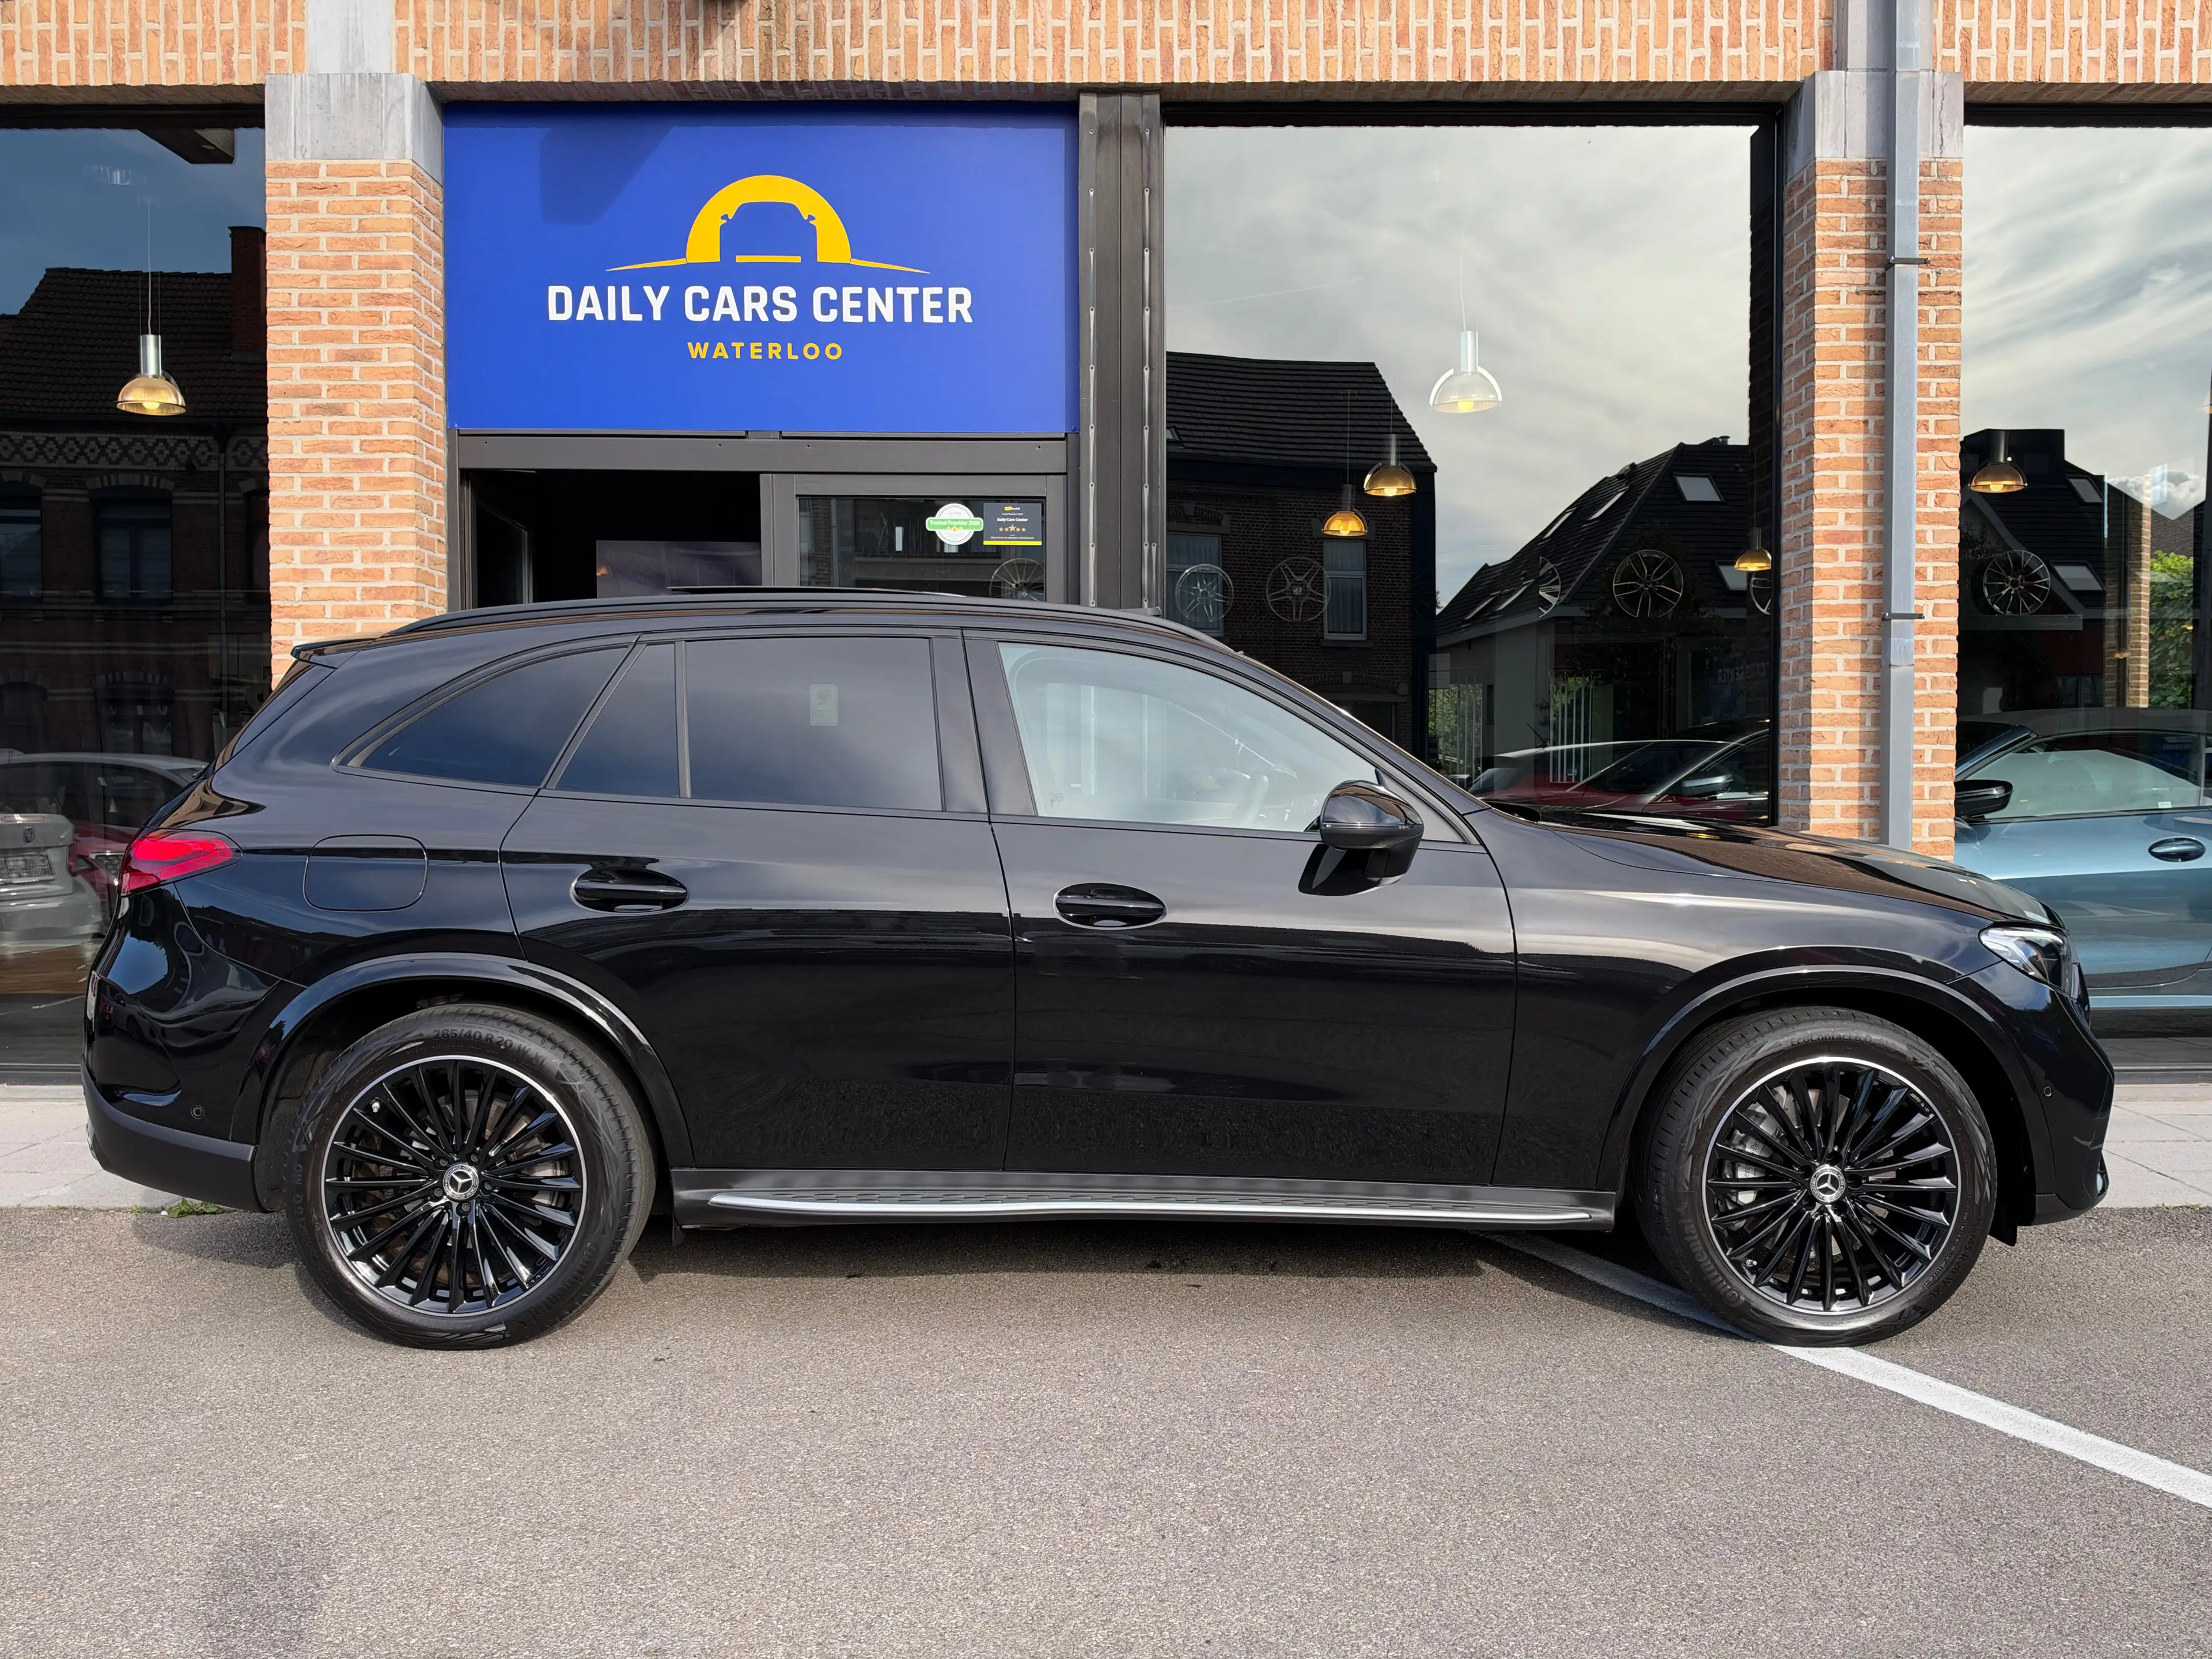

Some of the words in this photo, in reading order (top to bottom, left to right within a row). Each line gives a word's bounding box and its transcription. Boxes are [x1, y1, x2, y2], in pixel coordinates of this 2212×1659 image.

[548, 285, 670, 321] DAILY
[684, 286, 797, 321] CARS
[812, 286, 974, 323] CENTER
[687, 342, 843, 360] WATERLOO
[433, 1028, 482, 1041] 285/40
[484, 1032, 494, 1043] R
[495, 1035, 514, 1050] 20
[292, 1162, 304, 1184] MO
